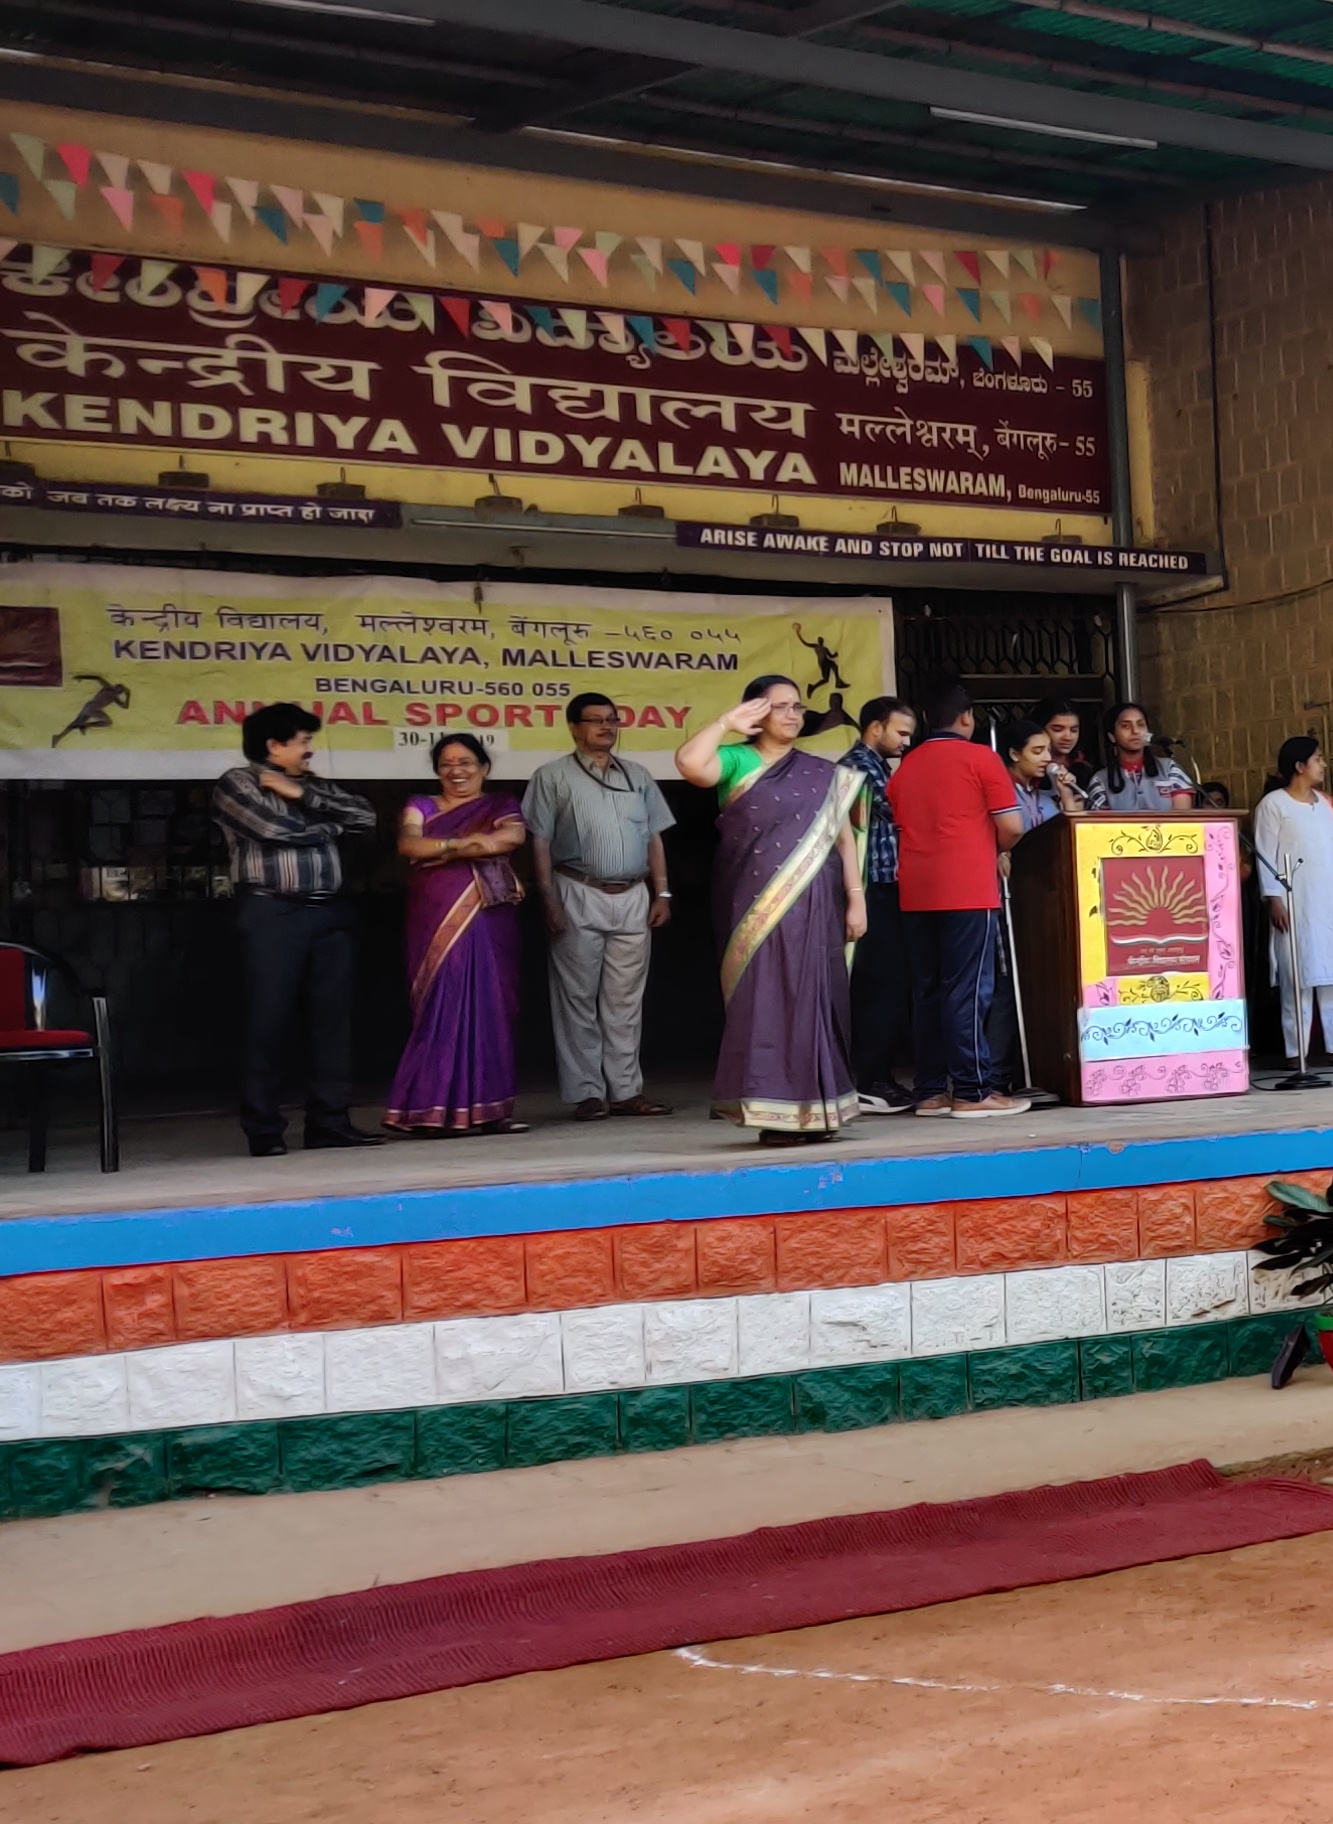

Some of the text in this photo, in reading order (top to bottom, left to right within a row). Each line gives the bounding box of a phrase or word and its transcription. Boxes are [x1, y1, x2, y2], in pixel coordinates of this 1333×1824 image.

[1, 310, 817, 439] केन्द्रीय विद्यालय
[1071, 378, 1094, 398] 55
[2, 389, 818, 485] KENDRIYA VIDYALAYA
[1074, 435, 1096, 457] 55
[839, 461, 1012, 503] MALLESWARAM,
[94, 493, 139, 508] तक
[299, 502, 324, 520] हो
[699, 528, 1190, 570] ARISE AWAKE AND STOP NOT TILL THE GOAL IS REACHED
[106, 603, 203, 633] केन्द्रीय
[214, 605, 329, 636] विद्यालय,
[113, 639, 738, 671] KENDRIYA VIDYALAYA, MALLESWARAM
[315, 677, 571, 697] BENGALURU-560 055
[176, 699, 388, 726] ANAL
[617, 704, 692, 729] DAY
